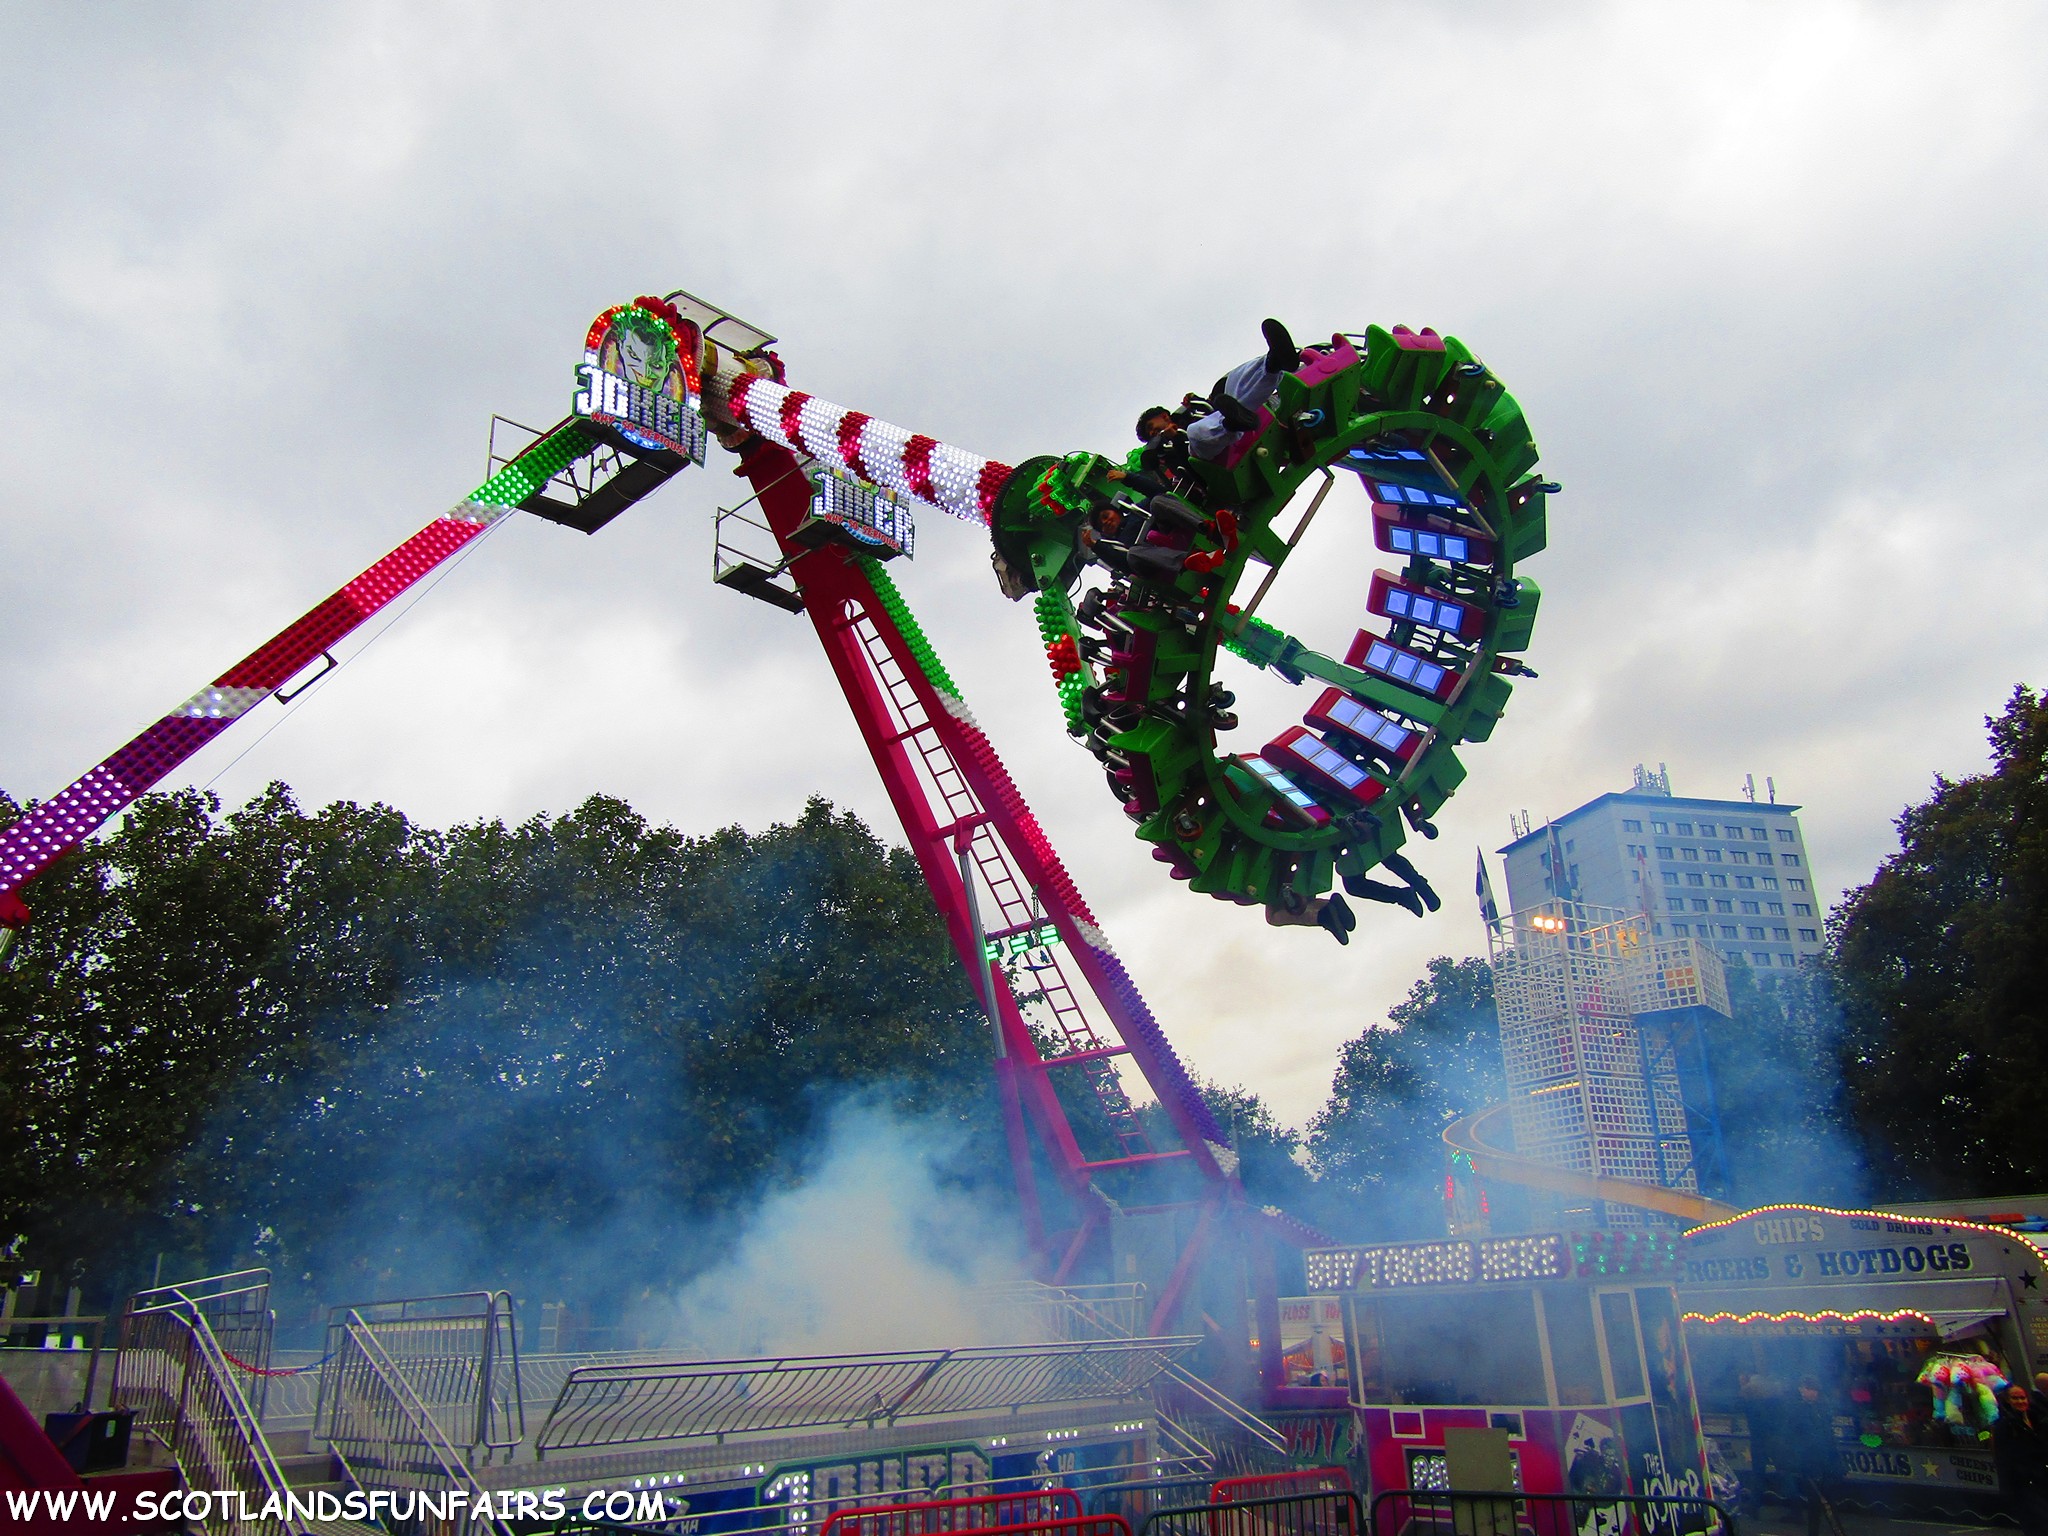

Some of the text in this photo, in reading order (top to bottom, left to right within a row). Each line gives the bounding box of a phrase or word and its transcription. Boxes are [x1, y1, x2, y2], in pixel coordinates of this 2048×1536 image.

[576, 366, 704, 463] JOKER
[590, 412, 615, 426] WHY
[814, 472, 913, 555] JOKER
[824, 513, 843, 525] WHY
[1754, 1216, 1825, 1245] CHIPS
[1850, 1219, 1933, 1235] COLD DRINKS
[1307, 1235, 1560, 1290] BUY TOKENS HERE
[1682, 1256, 1770, 1281] RGERS
[1816, 1243, 1972, 1277] HOTDOGS
[1643, 1453, 1661, 1476] THE
[1957, 1469, 1994, 1486] CHIPS
